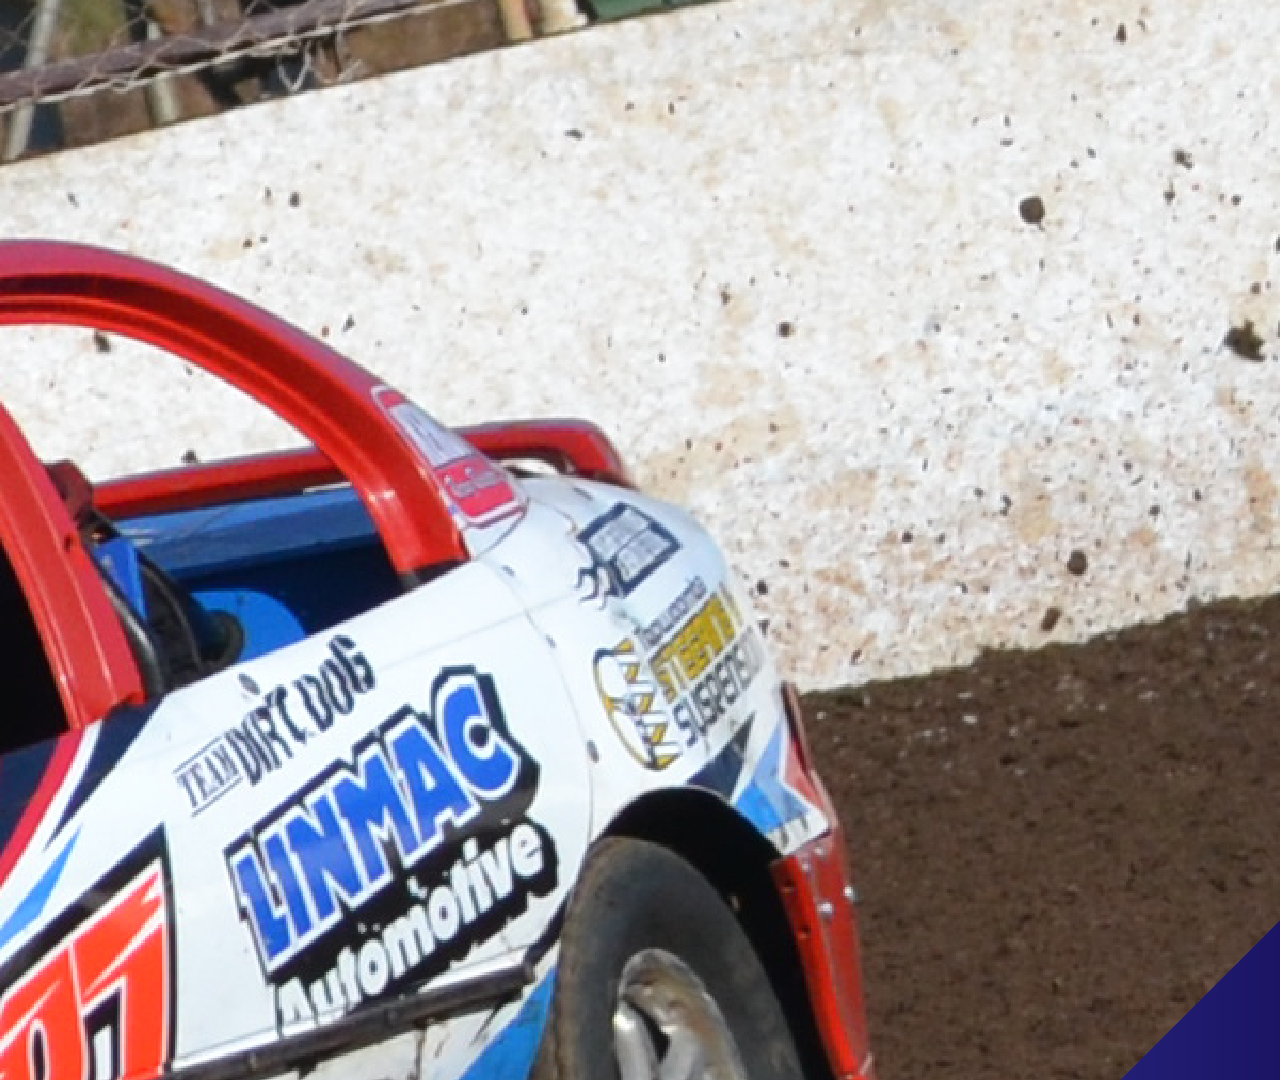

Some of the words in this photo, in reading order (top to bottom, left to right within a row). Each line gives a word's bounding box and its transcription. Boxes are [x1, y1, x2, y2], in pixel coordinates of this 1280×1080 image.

[177, 742, 240, 809] TEAM
[224, 684, 308, 787] DIRT
[293, 634, 377, 733] DOG
[228, 667, 530, 975] LINMAC
[276, 820, 548, 1037] Automotive
